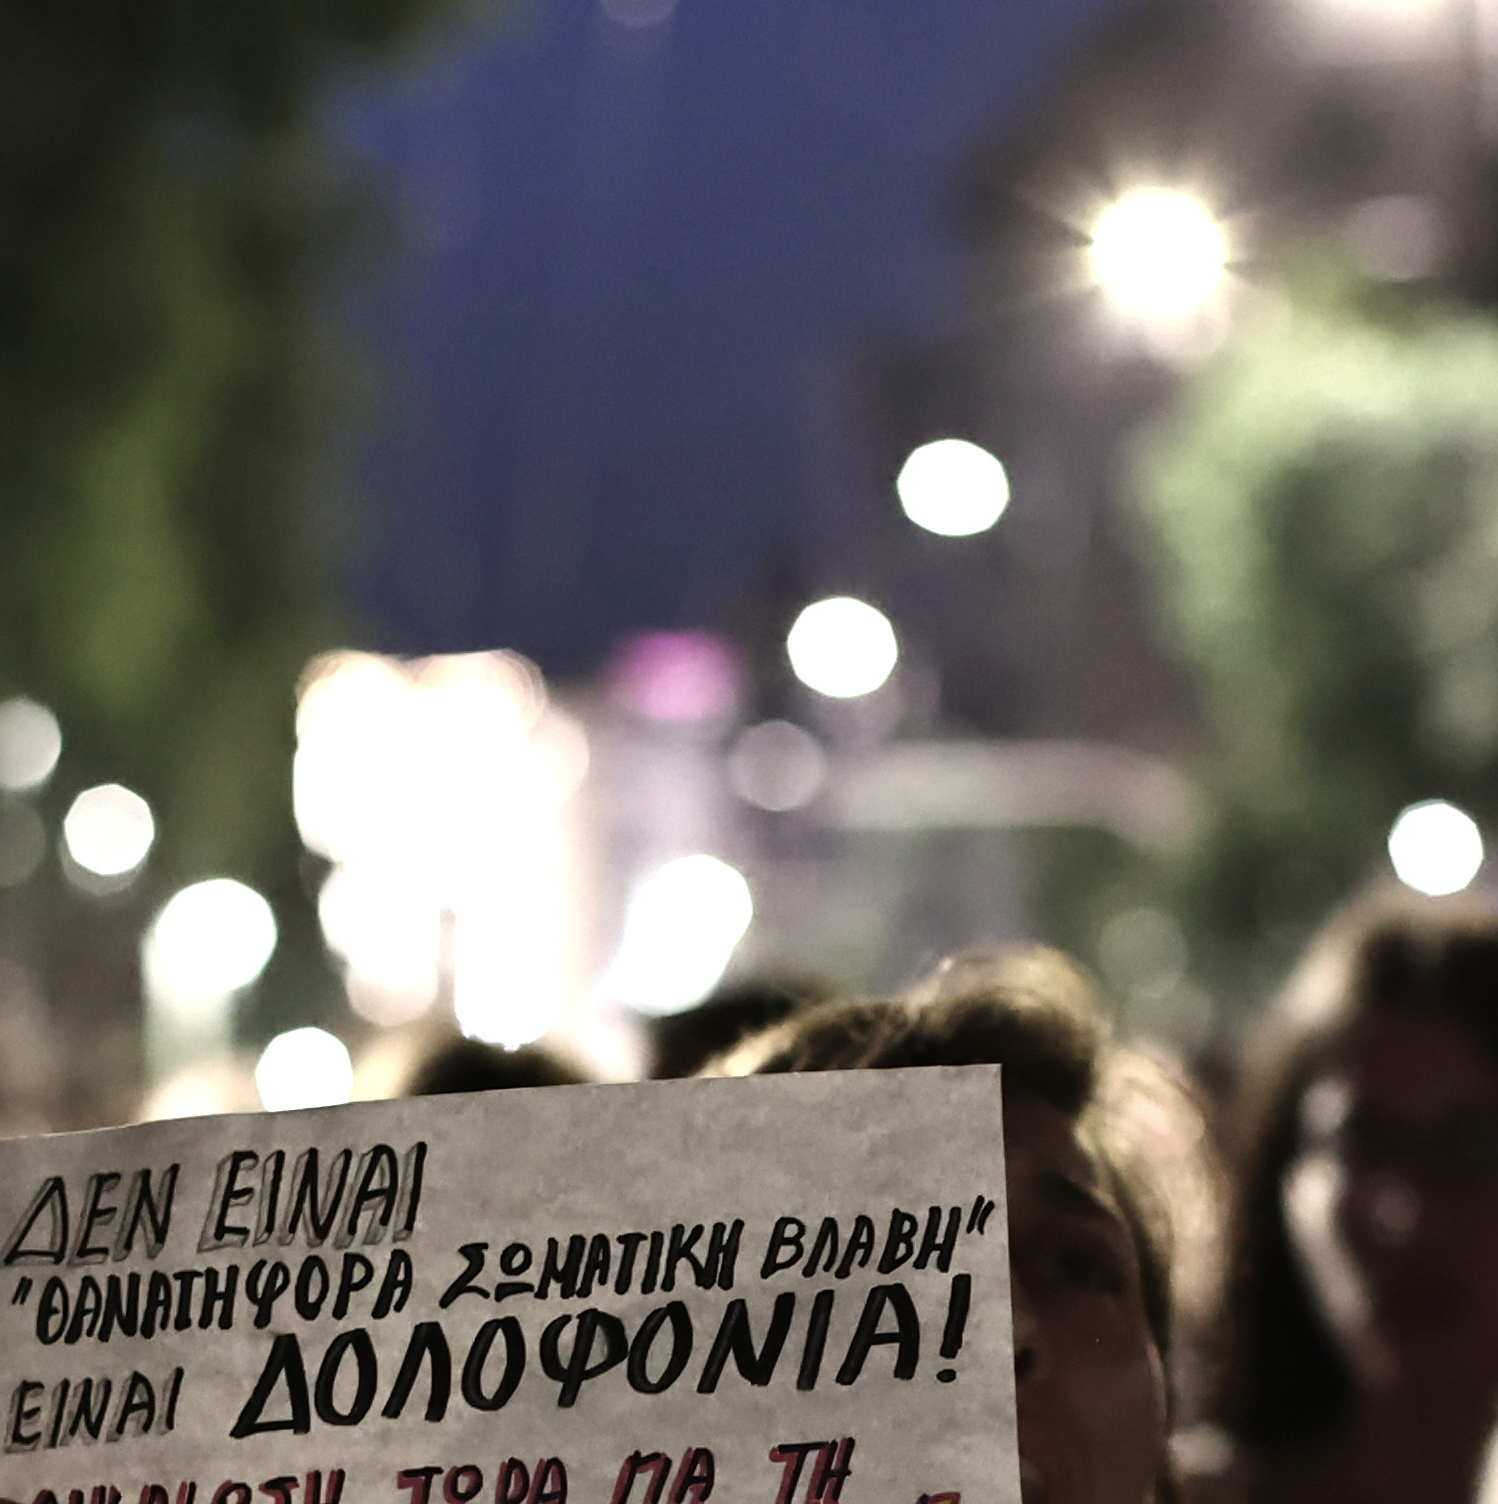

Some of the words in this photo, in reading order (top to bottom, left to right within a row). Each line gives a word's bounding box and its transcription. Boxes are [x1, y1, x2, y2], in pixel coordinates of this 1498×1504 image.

[197, 1141, 428, 1254] ΕΙΝΑΙ
[439, 1218, 745, 1308] ΣΩΜΑΤΙΚΗ
[4, 1366, 185, 1454] ΕΙΝΑΙ
[229, 1273, 972, 1439] ΔΟΛΟΦΟΝΙΑ!
